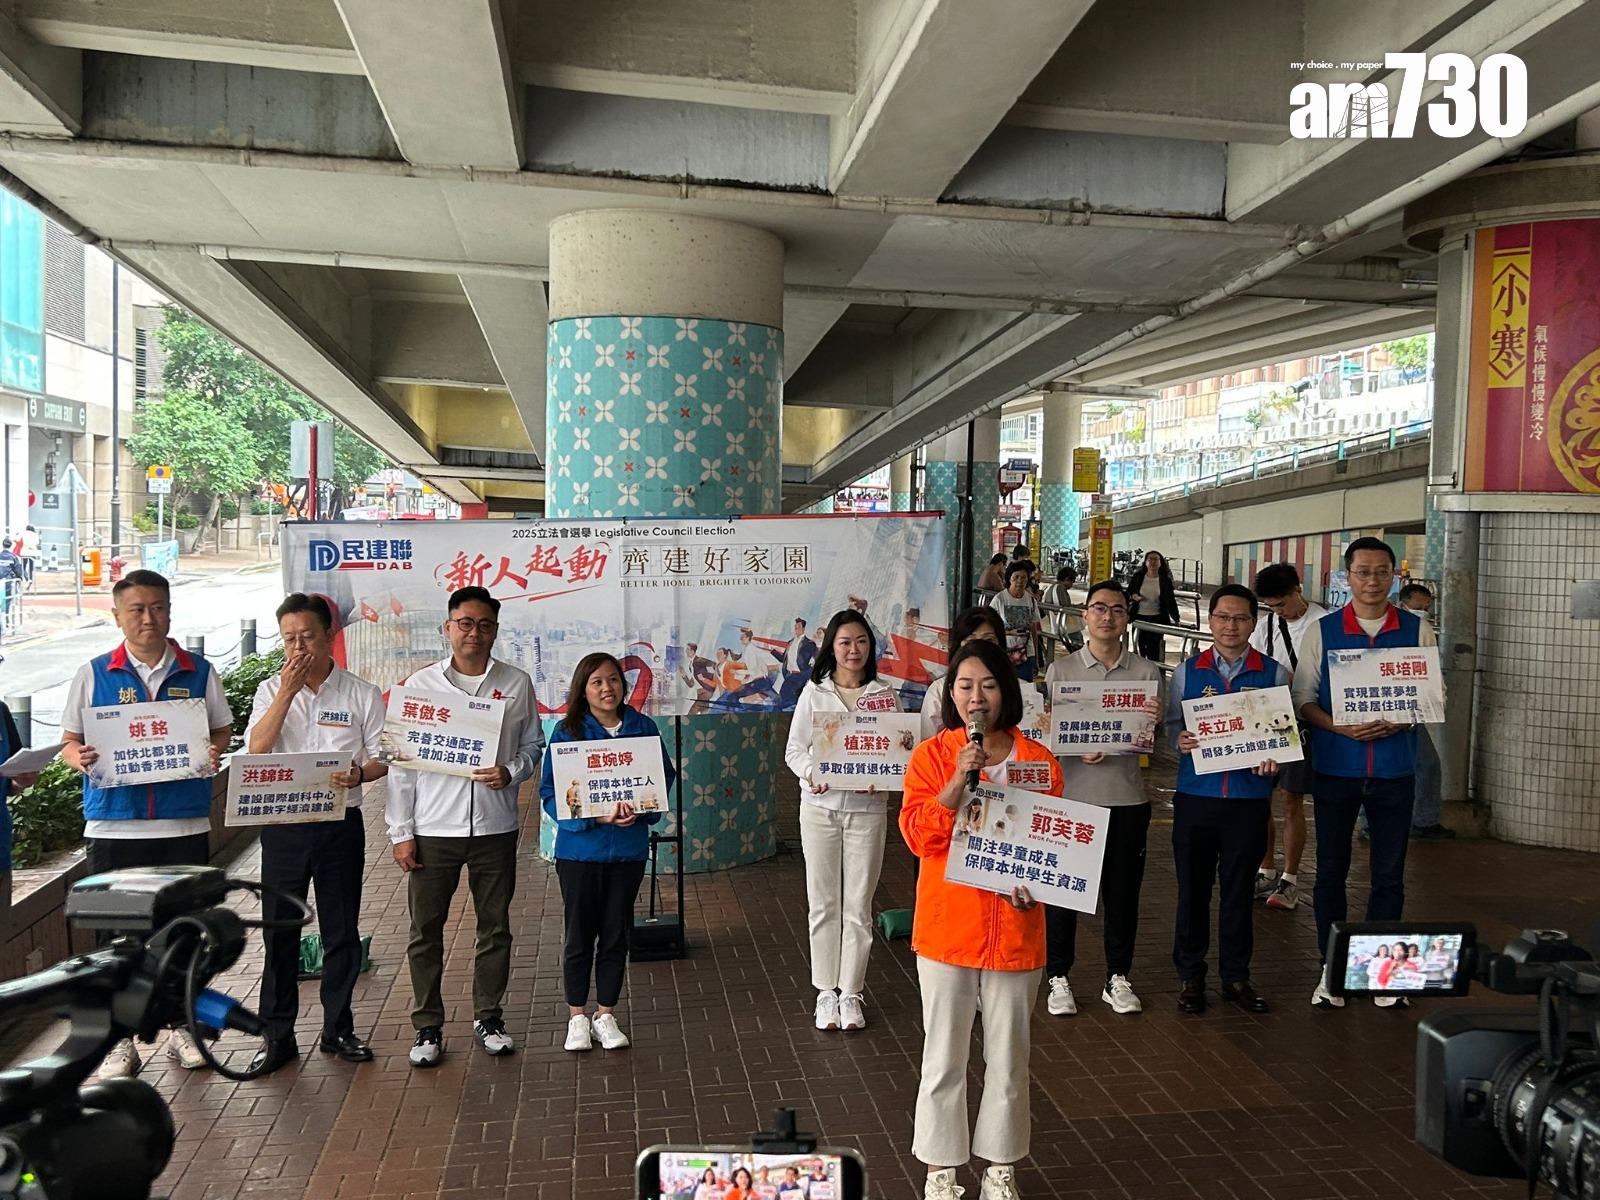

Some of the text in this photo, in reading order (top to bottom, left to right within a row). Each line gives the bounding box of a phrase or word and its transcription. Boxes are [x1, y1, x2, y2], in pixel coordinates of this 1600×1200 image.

[1491, 272, 1528, 369] 小寒
[1529, 324, 1549, 441] 氣候慢慢變冷
[511, 526, 736, 539] 2025立法會選舉 Legislative Council Election
[342, 538, 413, 560] 民建聯
[376, 561, 413, 570] DAB
[444, 542, 608, 592] 新人起動
[622, 545, 809, 576] 齊建好家園
[620, 580, 659, 588] BETTER
[699, 577, 750, 587] BRIGHTER
[753, 575, 813, 587] TOMORROW
[1379, 661, 1428, 677] 張培剛
[118, 687, 138, 703] 姚
[1343, 685, 1418, 699] 實現置業夢想
[401, 701, 452, 723] 葉傲冬
[866, 697, 896, 711] 植潔鈴
[1344, 699, 1419, 713] 改善居住環境
[128, 719, 169, 738] 姚銘
[1059, 720, 1123, 731] 發展綠色航運
[1197, 716, 1246, 736] 朱立威
[406, 729, 486, 753] 完善交通配套
[843, 734, 891, 751] 植潔鈴
[1057, 733, 1132, 744] 推動建立企業通
[112, 743, 189, 761] 加快北都發展
[1201, 736, 1290, 759] 開發多元旅遊產品
[416, 746, 482, 768] 增加泊車位
[586, 751, 634, 769] 盧婉婷
[114, 757, 191, 775] 拉動香港經濟
[819, 762, 909, 776] 爭取優質退休生
[242, 767, 295, 784] 洪錦鉉
[587, 775, 655, 792] 保障本地工人
[1007, 768, 1051, 784] 郭芙蓉
[238, 790, 336, 805] 建設國際創科中心
[588, 788, 635, 804] 優先就業
[236, 802, 334, 817] 推進數字經濟建設
[1030, 811, 1095, 845] 郭芙蓉
[967, 835, 1059, 868] 關注學童成長
[964, 852, 1088, 893] 保障本地學生資源
